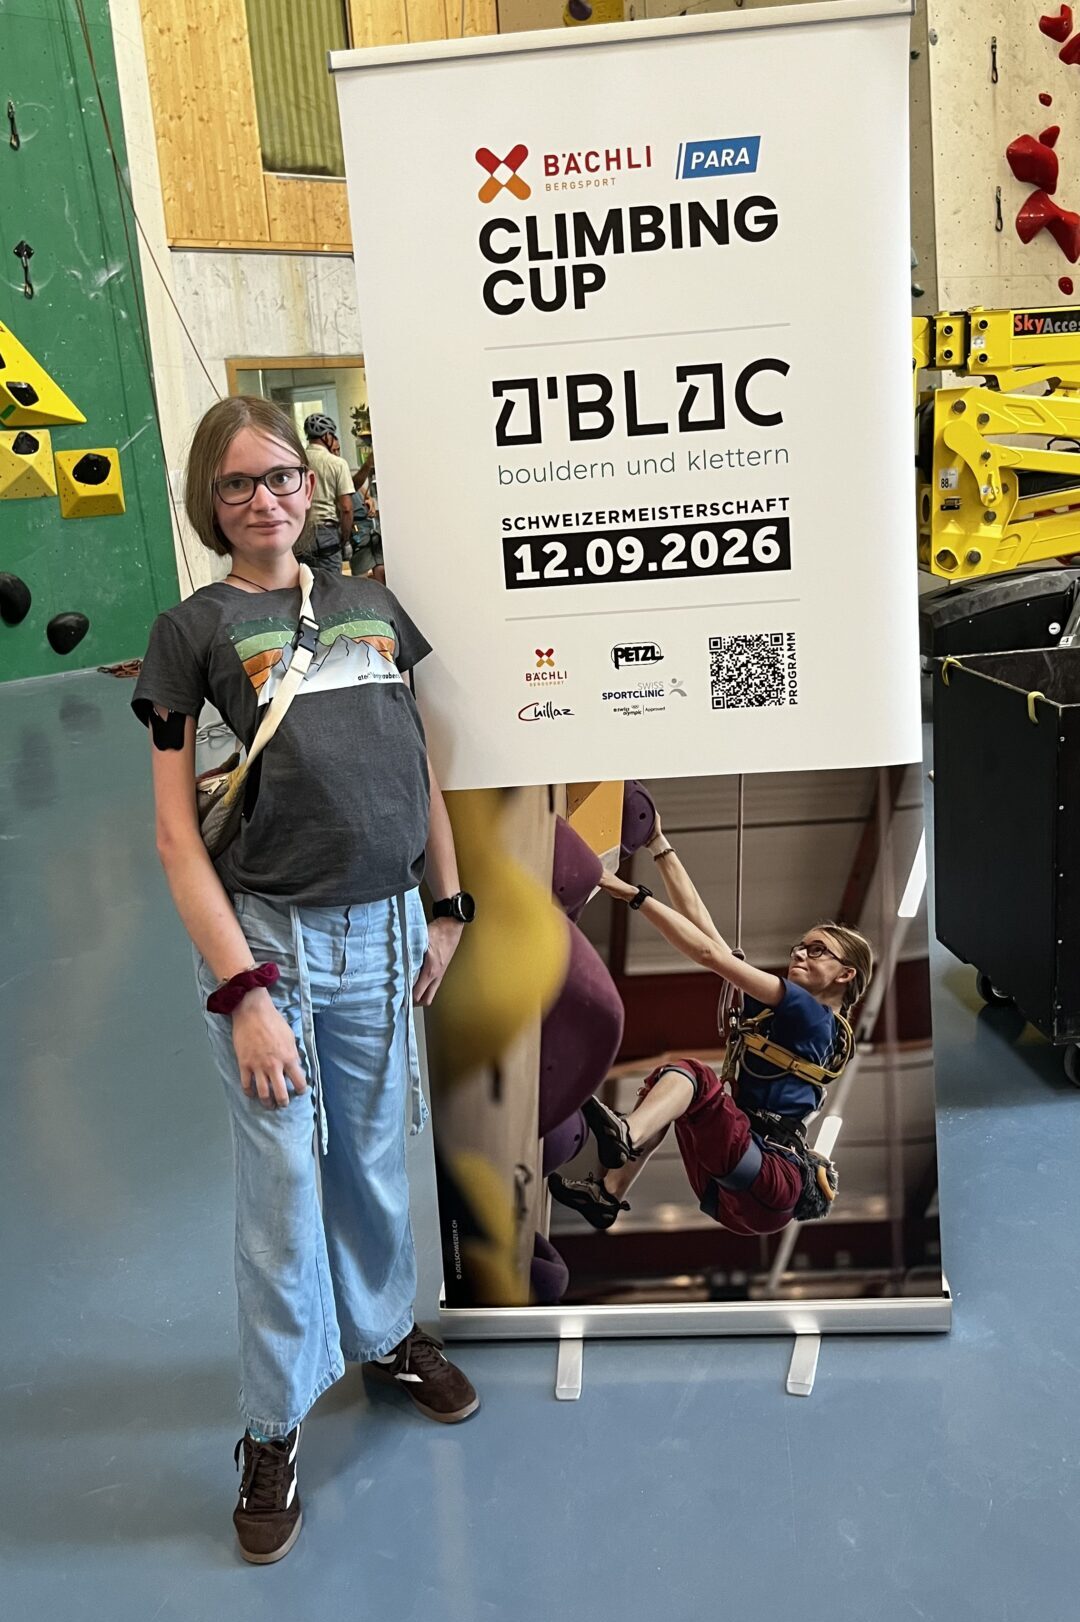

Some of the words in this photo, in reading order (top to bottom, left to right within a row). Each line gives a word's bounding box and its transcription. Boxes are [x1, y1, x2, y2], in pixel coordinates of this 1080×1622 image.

[544, 145, 652, 177] BÄCHLI
[690, 147, 750, 170] PARA
[545, 177, 617, 192] BERGSPORT
[478, 195, 779, 264] CLIMBING
[482, 263, 607, 316] CUP
[498, 460, 615, 485] bouldern
[627, 452, 676, 476] und
[687, 448, 790, 472] klettern
[501, 497, 790, 531] SCHWEIZERMEISTERSCHAFT
[513, 525, 781, 581] 12.09.2026
[613, 645, 664, 670] PETZL
[786, 632, 798, 705] PROGRAMM
[525, 670, 567, 681] BÄCHLI
[637, 681, 664, 690] SWISS
[602, 689, 665, 700] SPORTCLINIC
[518, 701, 575, 721] Chillaz
